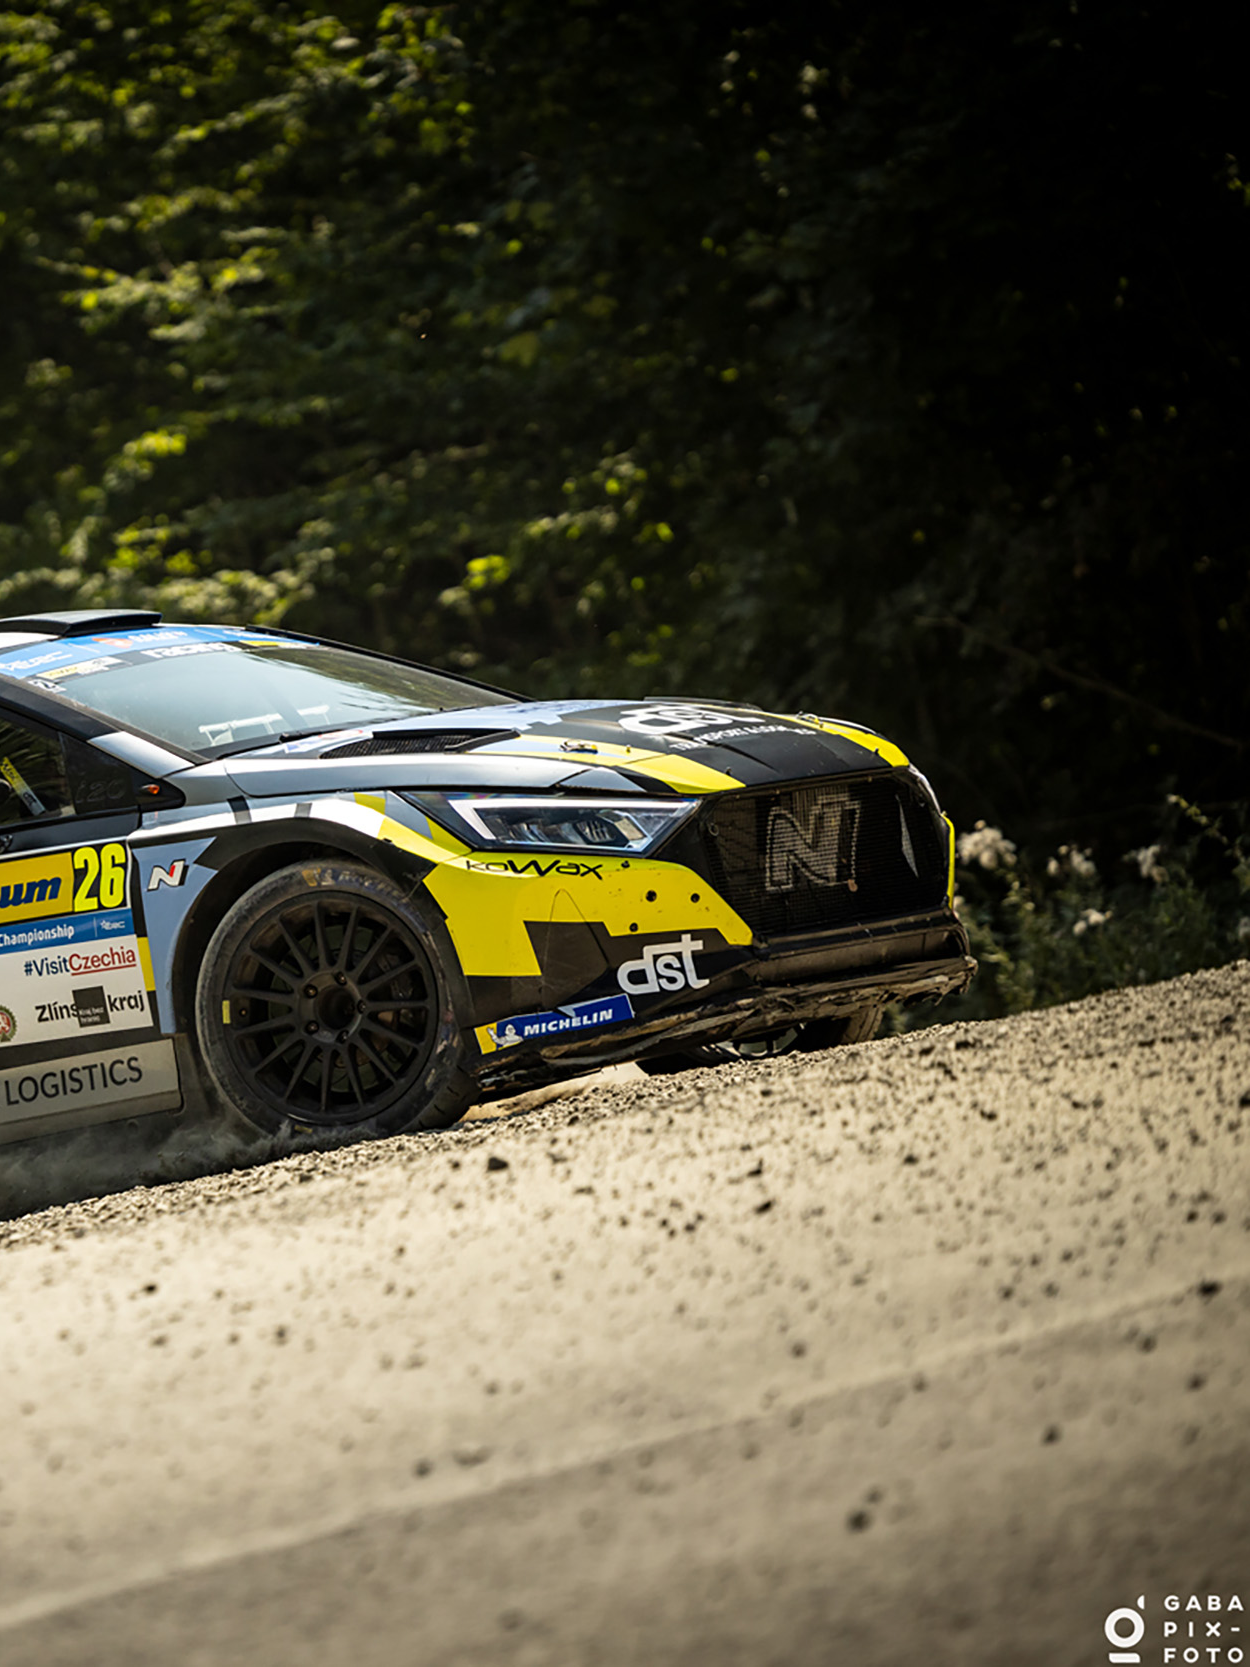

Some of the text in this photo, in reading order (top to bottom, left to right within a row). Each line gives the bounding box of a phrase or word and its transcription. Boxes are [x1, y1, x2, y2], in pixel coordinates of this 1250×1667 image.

[73, 842, 126, 912] 26
[617, 933, 710, 995] dst
[107, 989, 145, 1012] kraj
[524, 1008, 614, 1037] MICHELIN
[4, 1056, 143, 1105] LOGISTICS
